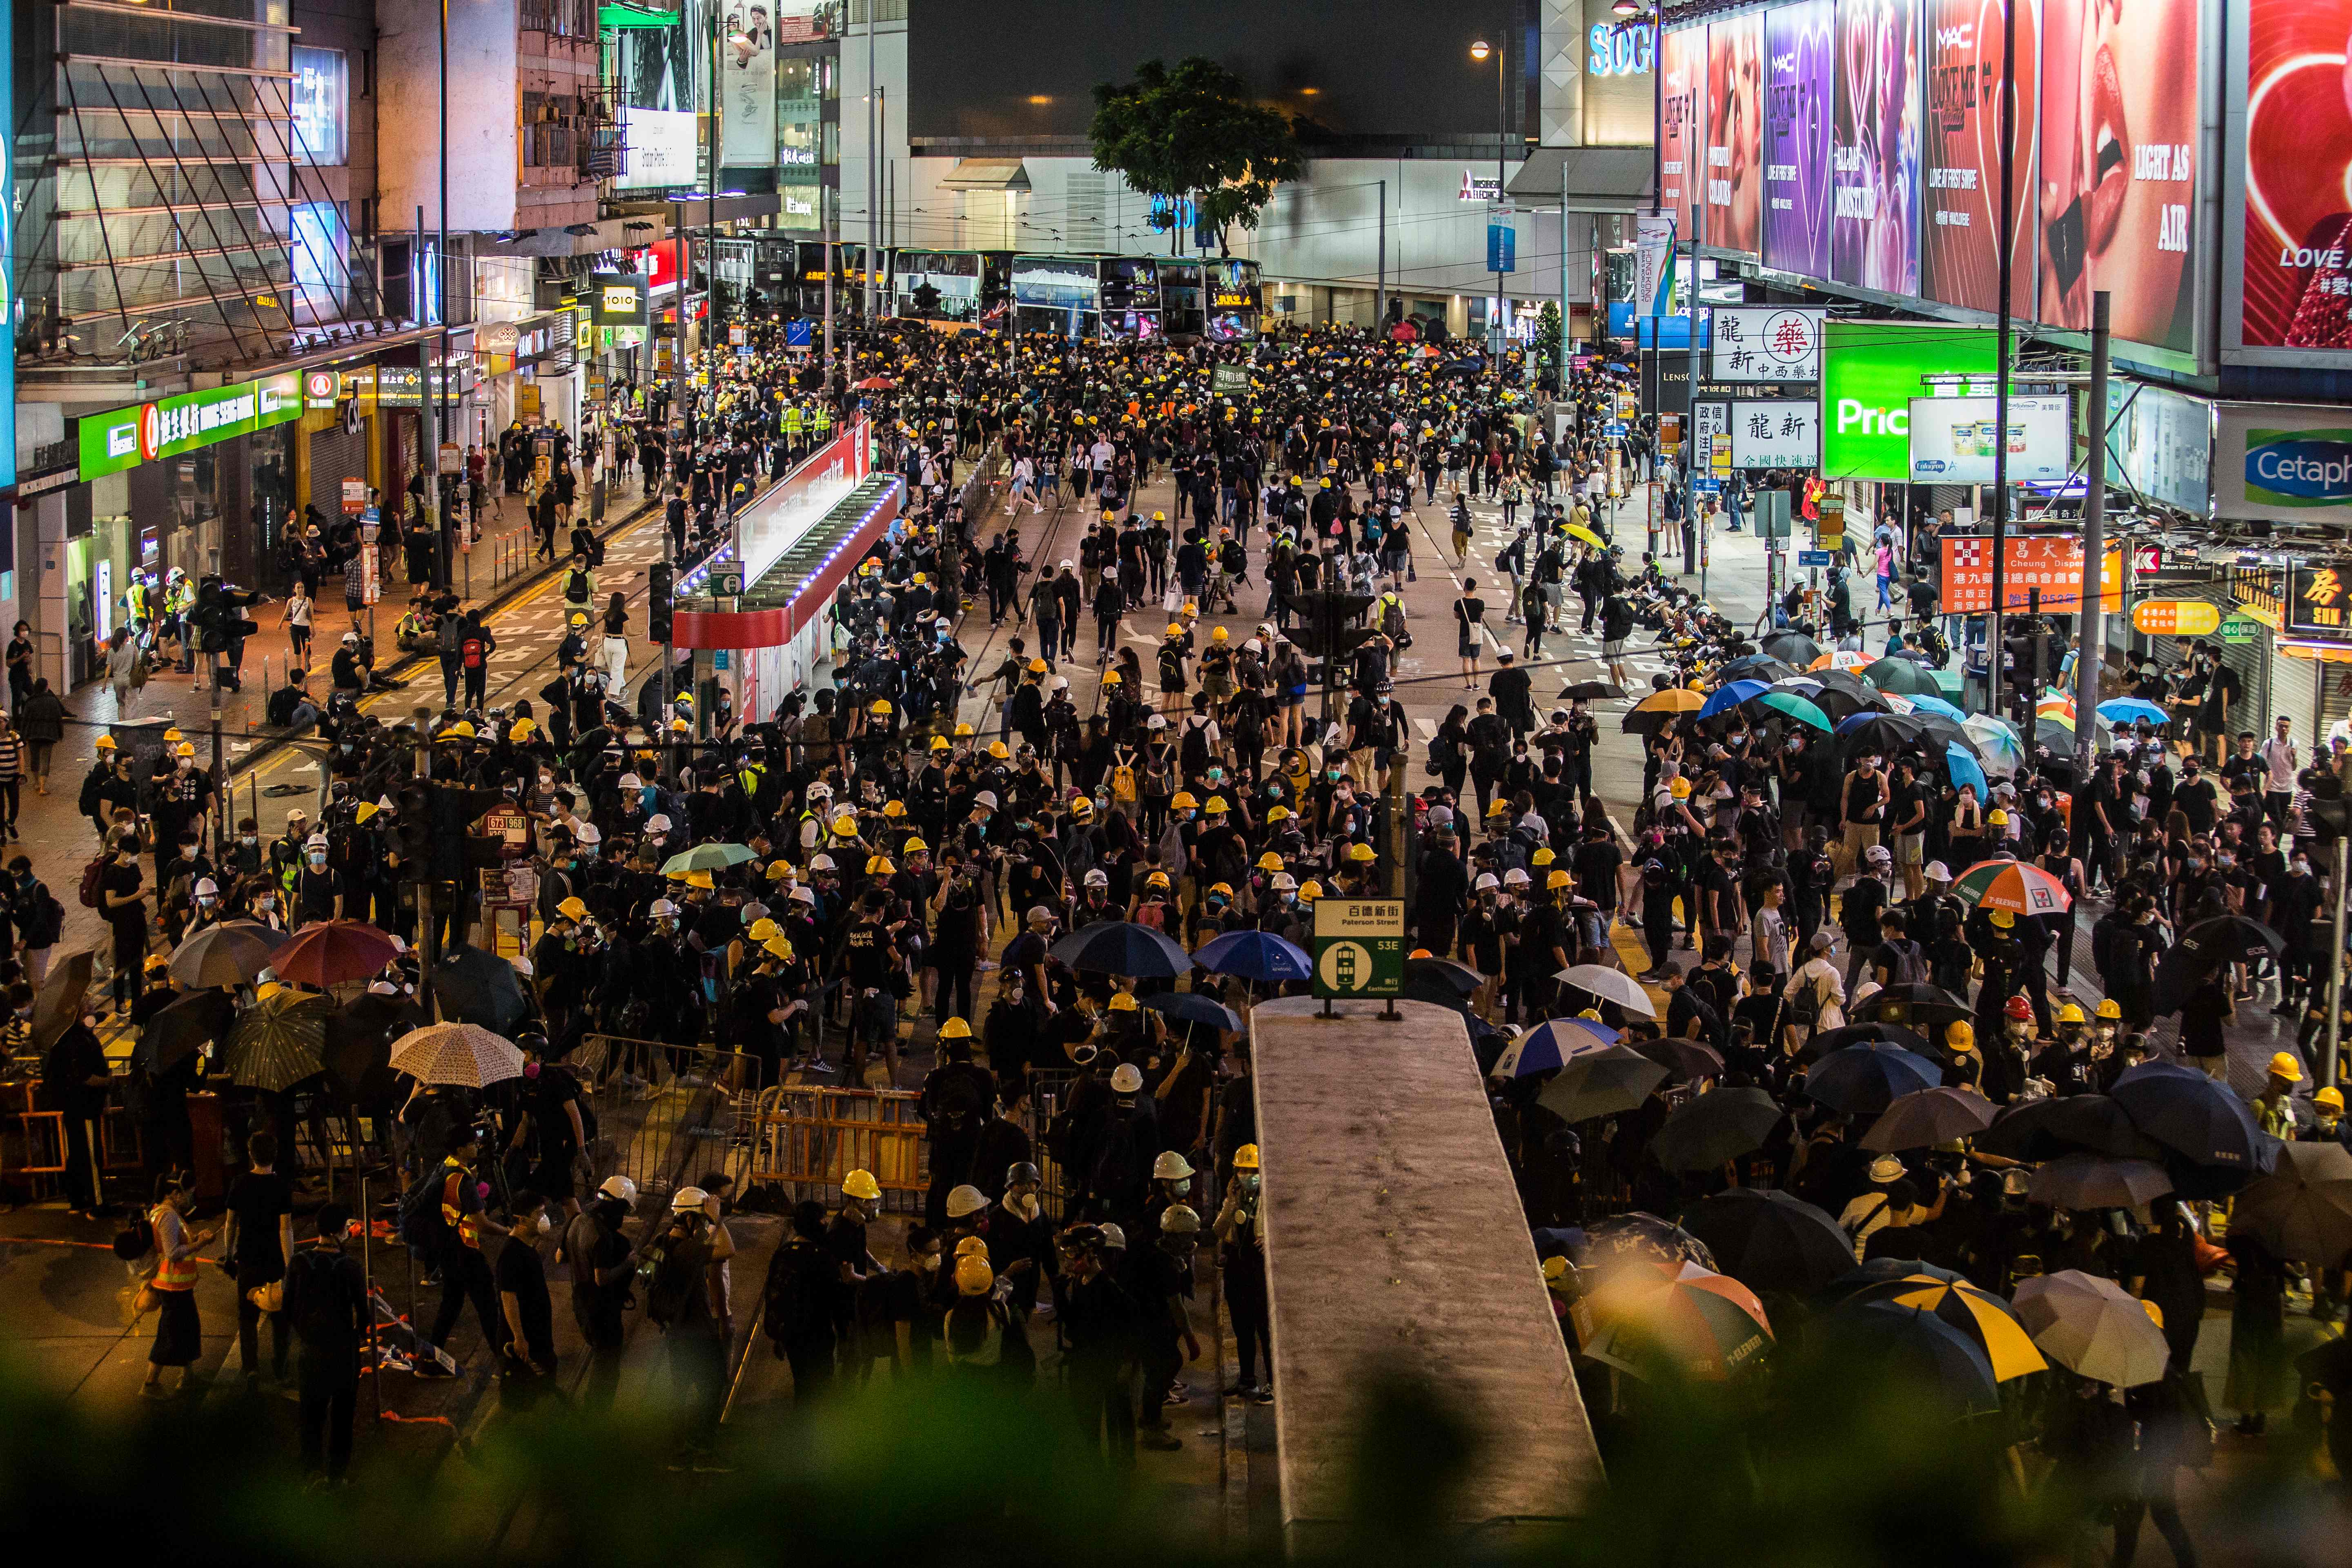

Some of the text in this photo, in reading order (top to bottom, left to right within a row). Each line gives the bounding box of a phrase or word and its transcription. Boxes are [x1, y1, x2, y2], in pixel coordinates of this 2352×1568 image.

[1937, 24, 1971, 51] MAC
[1589, 24, 1655, 75] SOG
[1772, 53, 1794, 74] MAC
[1709, 146, 1729, 167] POWERFUL
[1836, 146, 1860, 172] ALL-DAY
[2134, 144, 2189, 181] LIGHT AS
[1929, 168, 1977, 190] LOVE AT FIRST SWIPE
[1709, 179, 1731, 206] COLOURS
[1836, 186, 1875, 220] MOISTURE
[2158, 204, 2188, 253] AIR
[2280, 248, 2344, 268] LOVE
[1773, 318, 1808, 356] 藥
[1217, 370, 1247, 382] 可前進
[1748, 412, 1817, 441] 龍新
[2011, 560, 2046, 568] Cheung
[2009, 593, 2077, 606] 始于952年
[2313, 607, 2341, 625] SUN
[490, 820, 523, 829] 673 968
[1959, 884, 1982, 899] 7-ELEVEN
[1349, 905, 1399, 917] 百德新街
[1988, 896, 2022, 909] 7-ELEVEN
[1377, 941, 1399, 950] 53E
[2246, 946, 2268, 956] EOS
[1727, 1334, 1763, 1366] 7-ELEVEN
